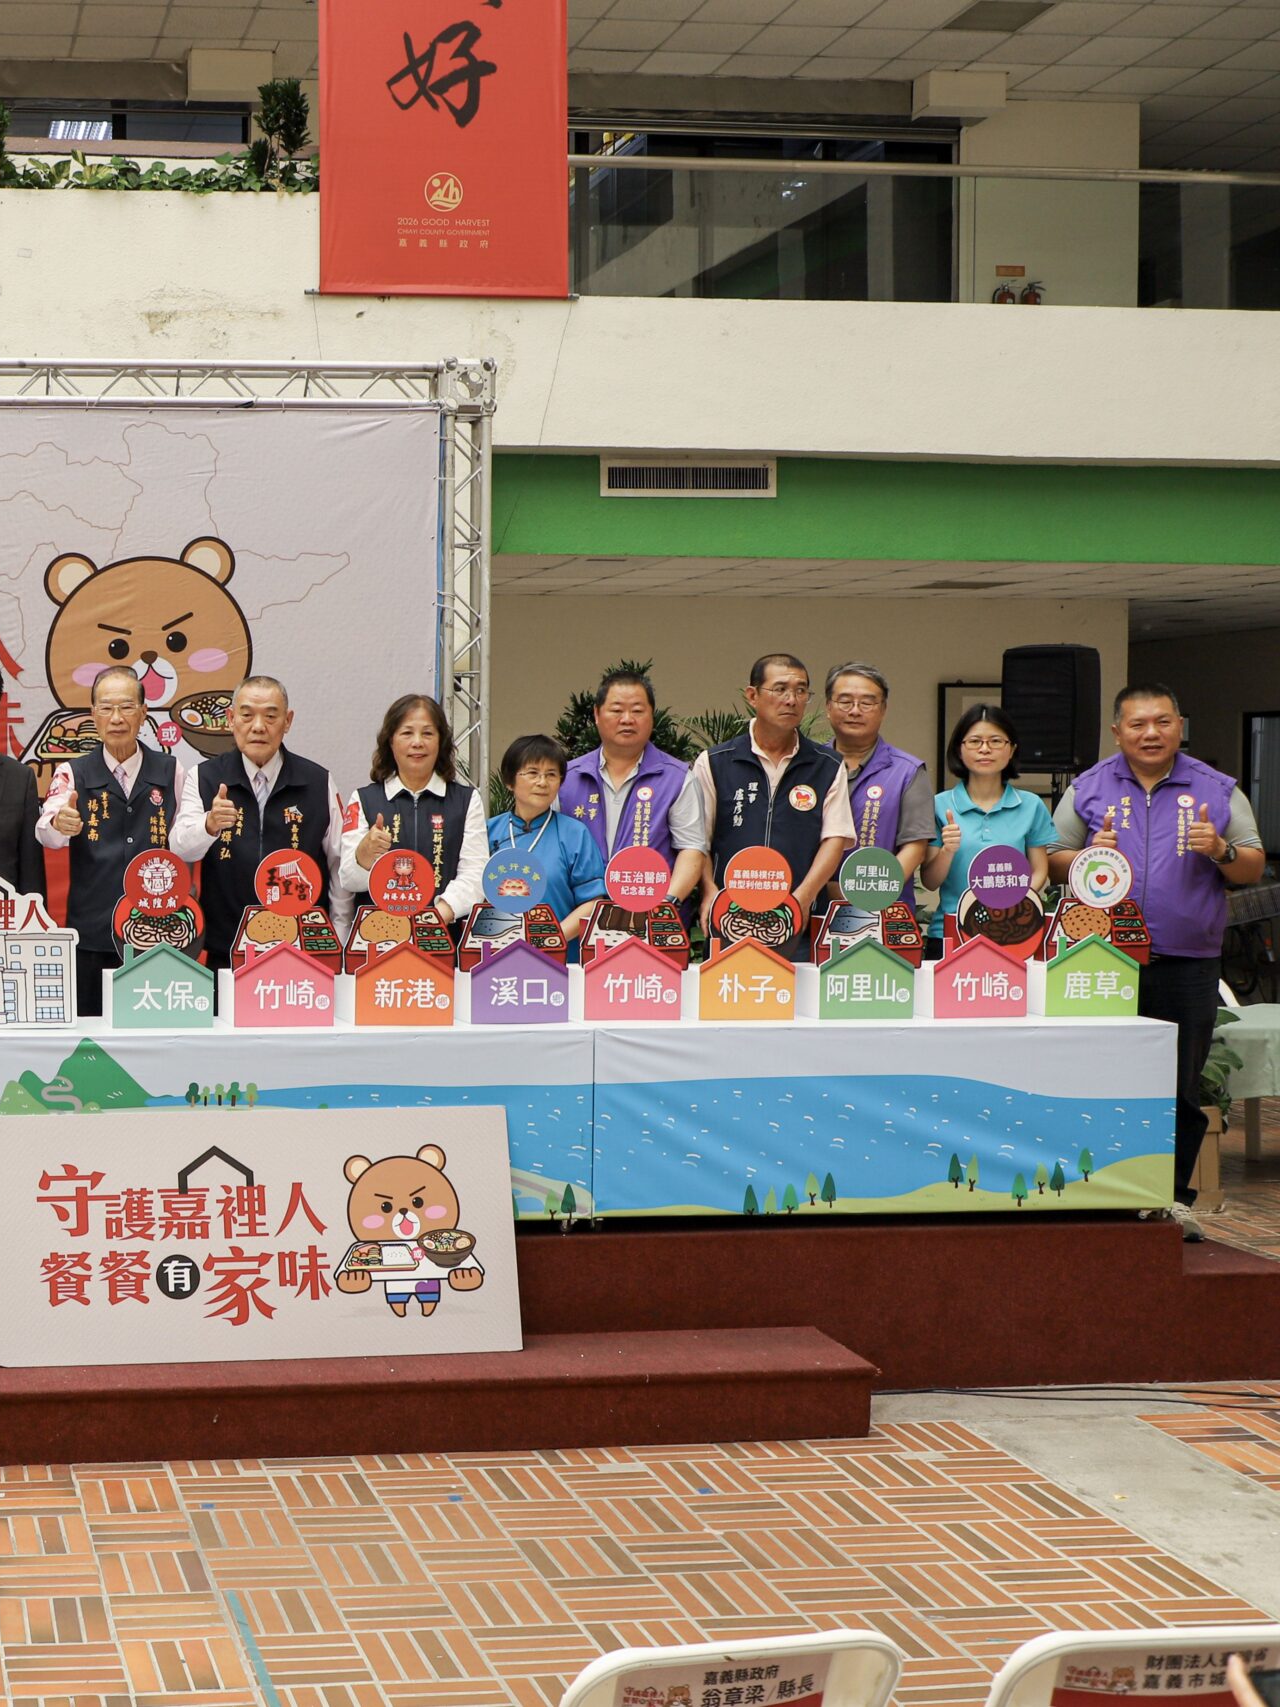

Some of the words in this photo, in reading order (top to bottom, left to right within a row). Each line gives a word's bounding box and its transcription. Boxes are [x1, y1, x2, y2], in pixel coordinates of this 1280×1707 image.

[386, 20, 498, 128] 好
[397, 217, 419, 226] 2026
[421, 218, 450, 226] GOOD
[455, 219, 490, 227] HARVEST
[161, 725, 177, 742] 或
[747, 782, 759, 804] 理事
[1121, 796, 1132, 829] 理事長
[856, 865, 890, 877] 阿里山
[988, 863, 1013, 873] 嘉義縣
[609, 871, 667, 884] 陳玉治醫師
[844, 879, 901, 892] 櫻山大飯店
[971, 874, 1030, 889] 大鵬慈和會
[620, 886, 655, 896] 紀念基金
[138, 896, 177, 909] 城隍廟
[36, 1163, 329, 1241] 守護嘉裡人
[39, 1245, 333, 1327] 餐餐有家味
[1145, 1647, 1268, 1670] 財團法人省
[703, 1665, 780, 1685] 嘉義縣政府
